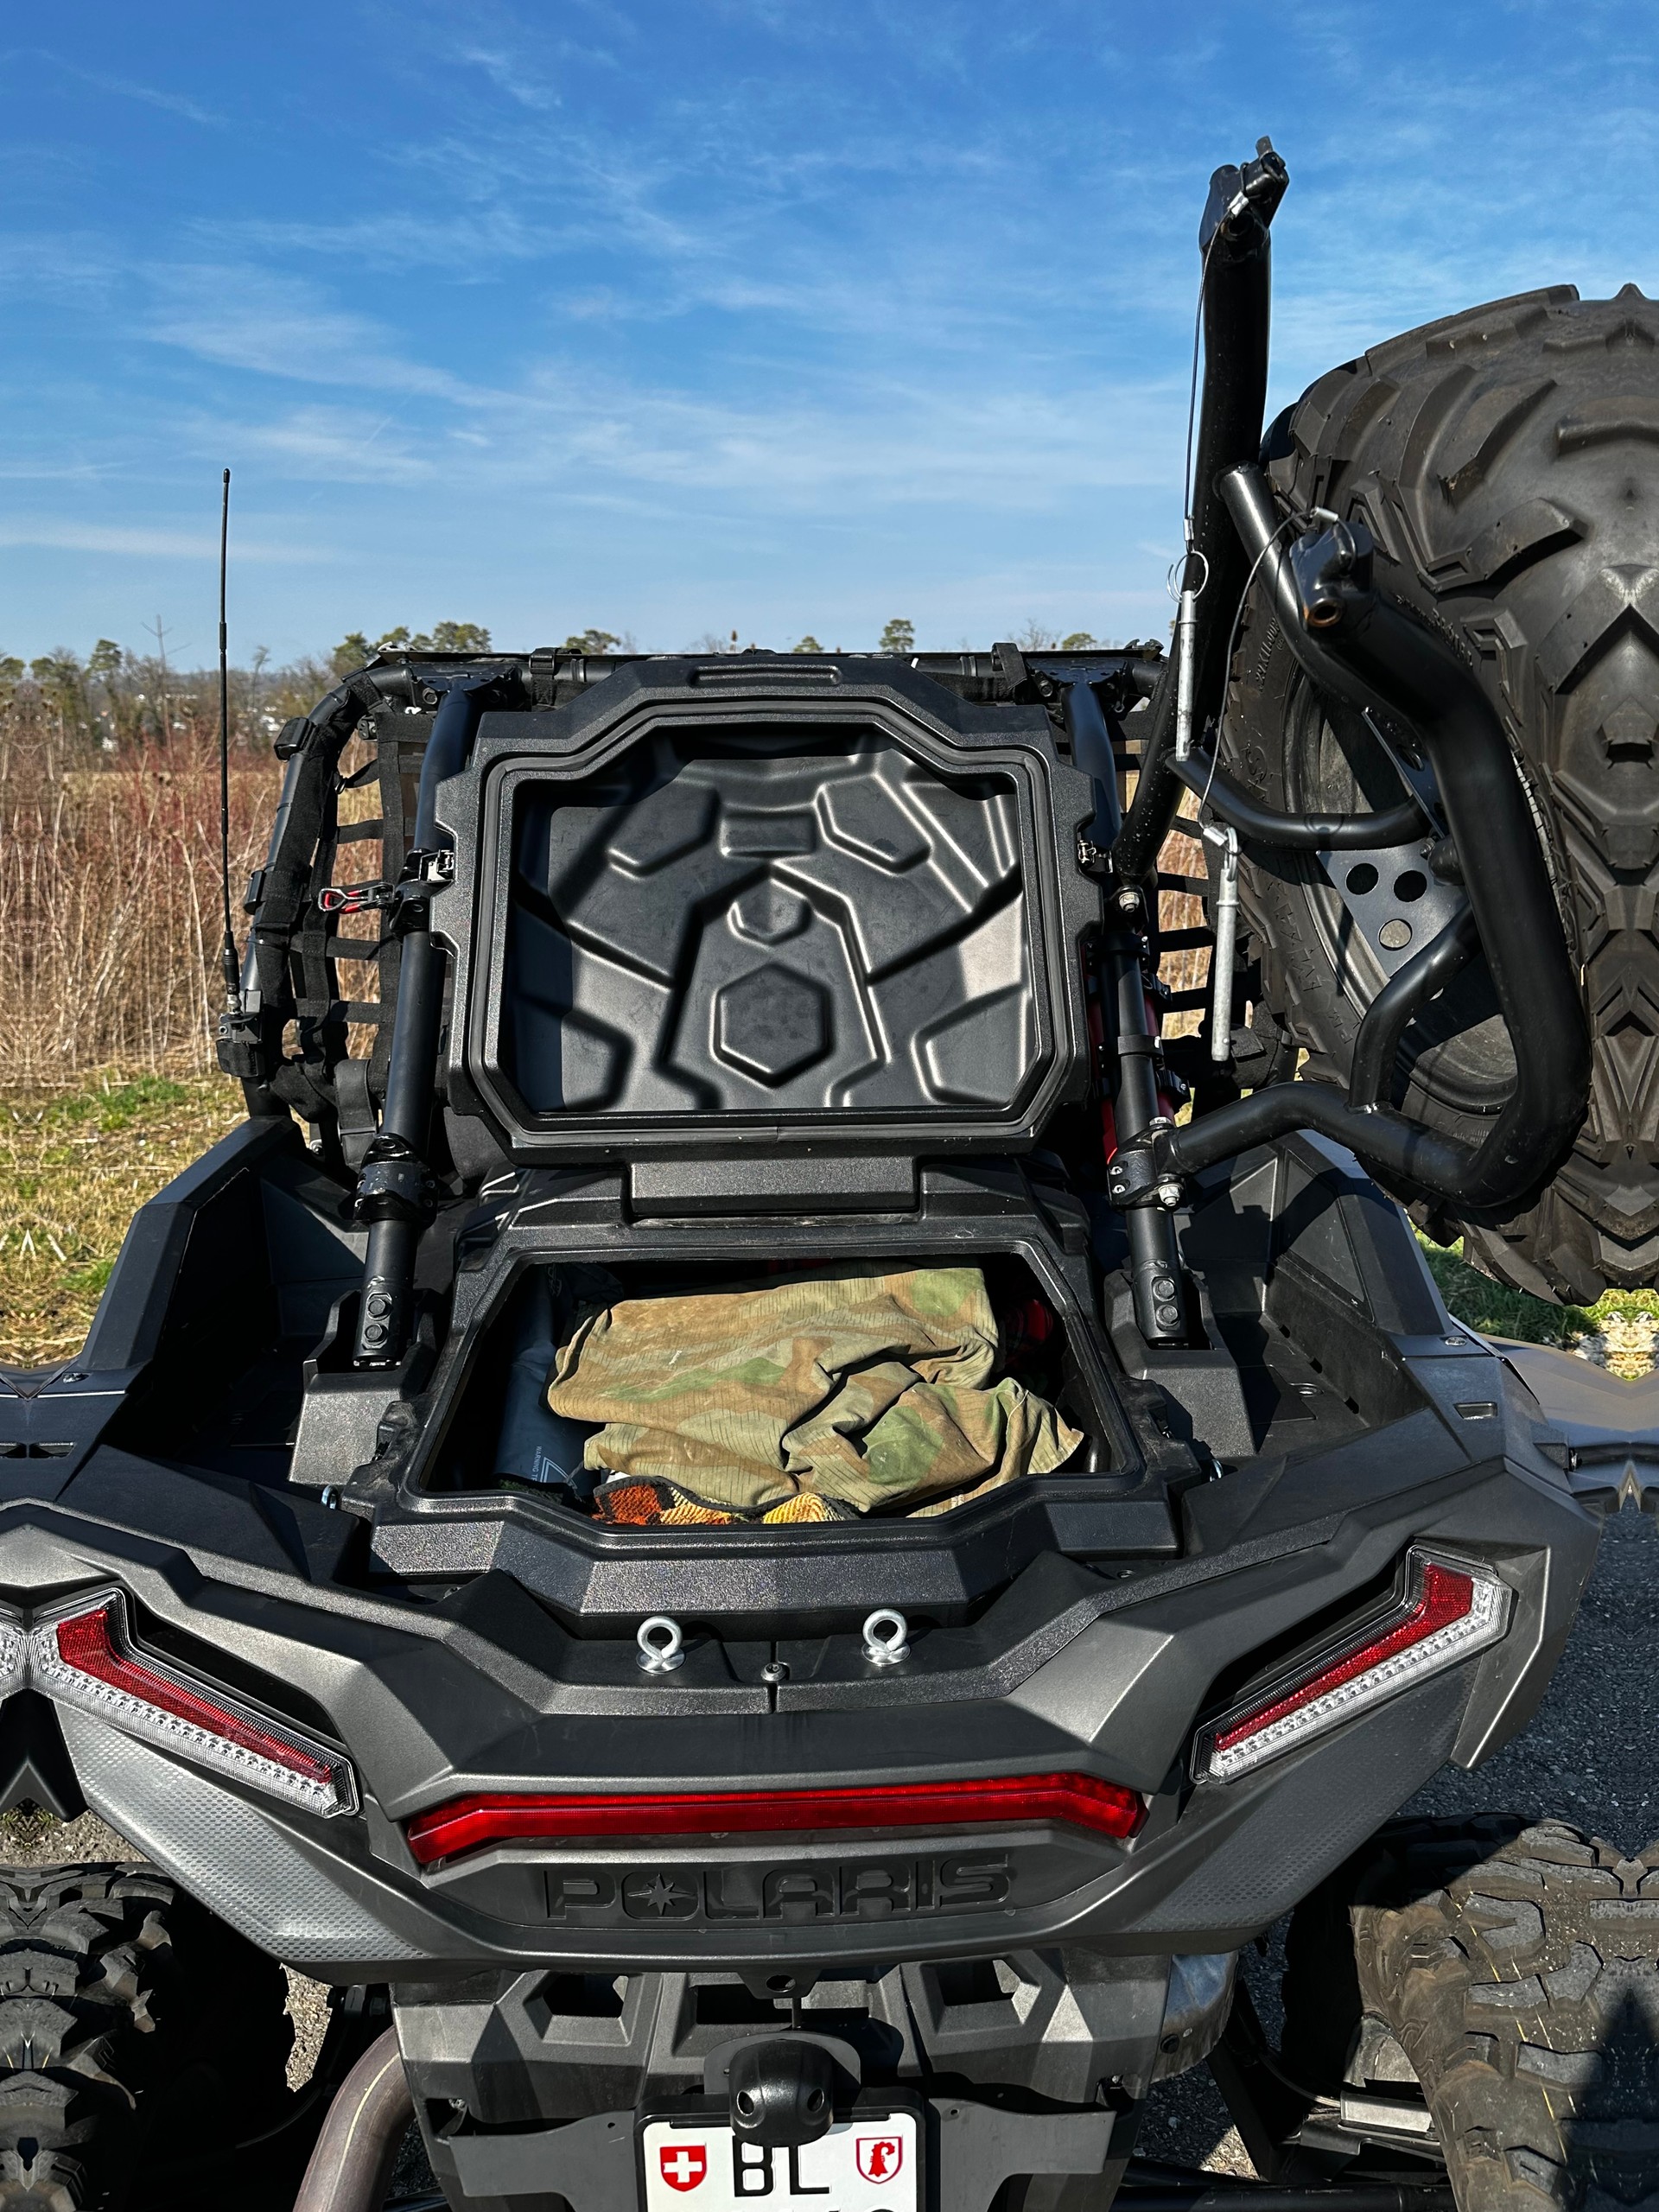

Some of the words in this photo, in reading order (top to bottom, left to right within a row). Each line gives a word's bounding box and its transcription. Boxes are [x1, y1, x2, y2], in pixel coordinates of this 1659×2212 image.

[531, 1446, 543, 1472] WARNING
[544, 1853, 1010, 1921] POLARIS
[732, 2134, 830, 2197] BL
